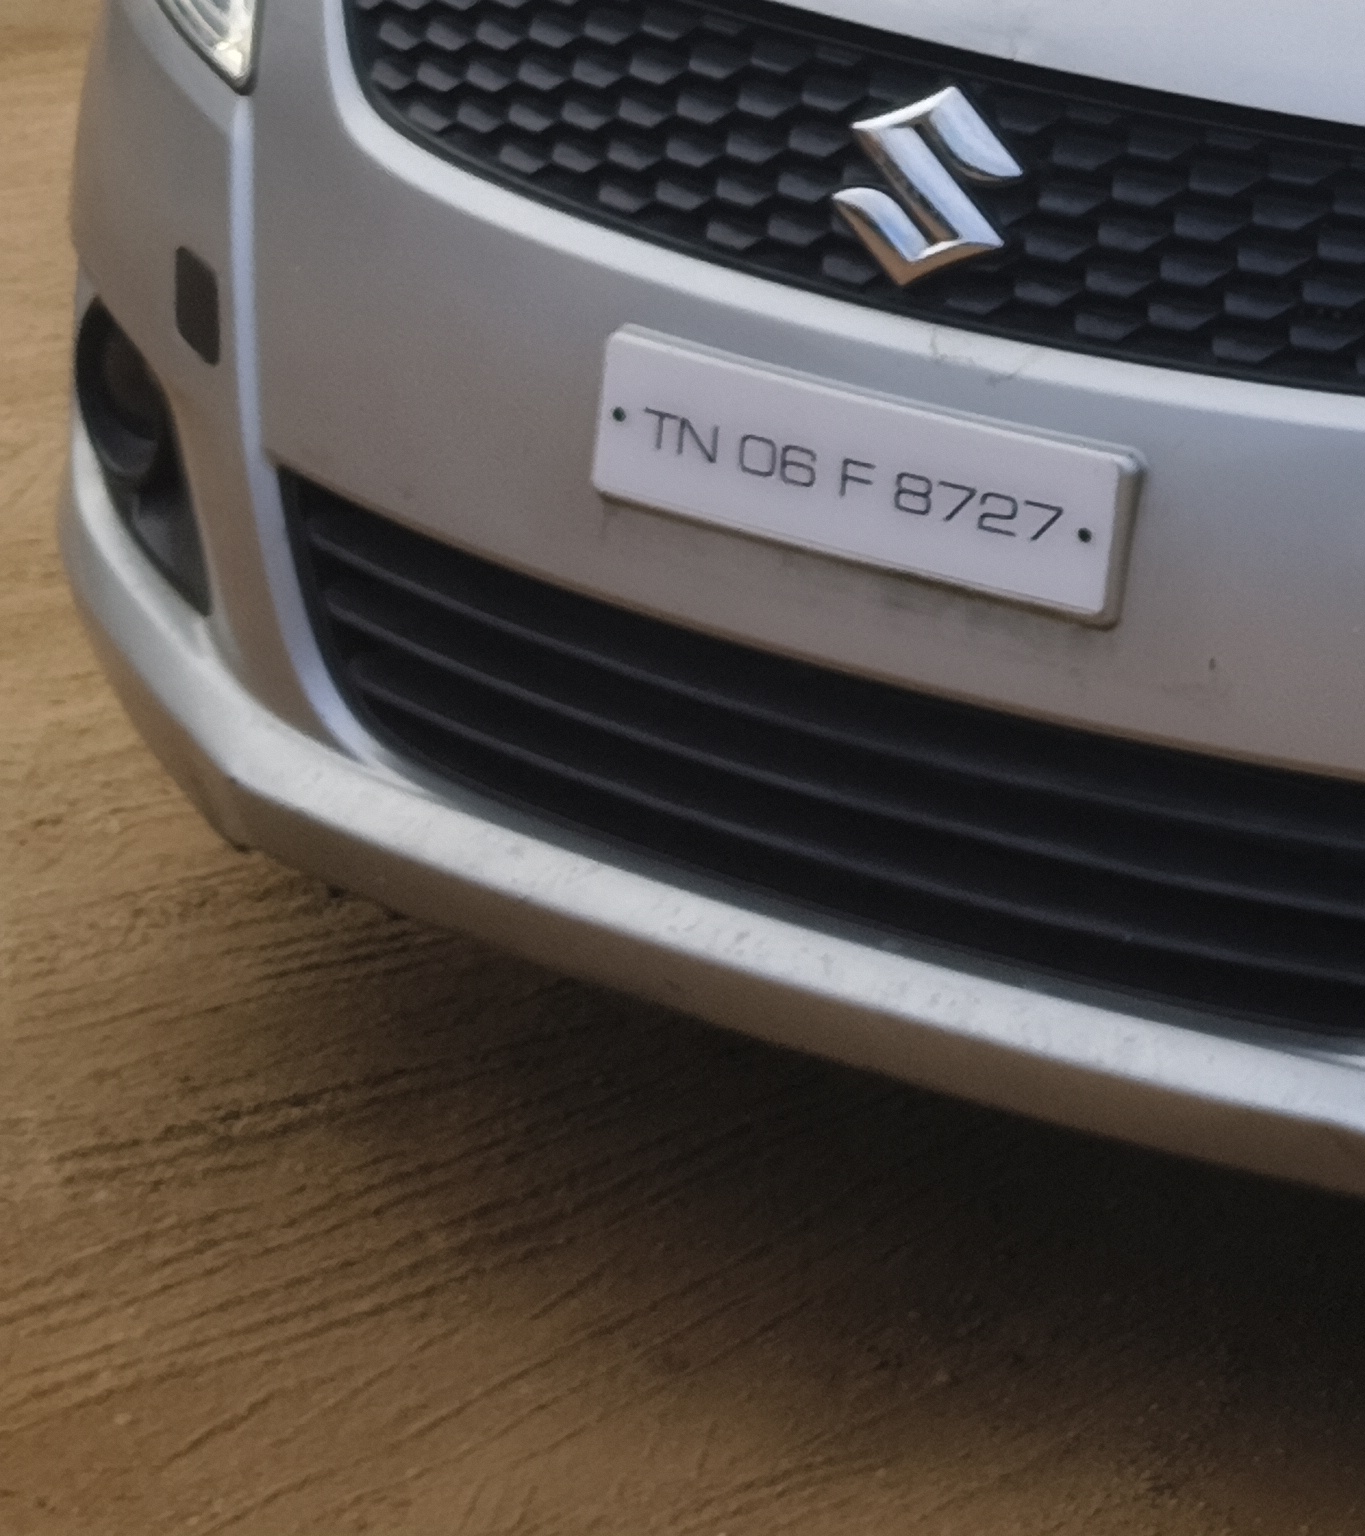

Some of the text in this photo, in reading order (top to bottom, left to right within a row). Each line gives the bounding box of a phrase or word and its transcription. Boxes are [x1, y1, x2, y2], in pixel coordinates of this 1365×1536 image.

[643, 406, 1065, 542] TN 06 F 8727
